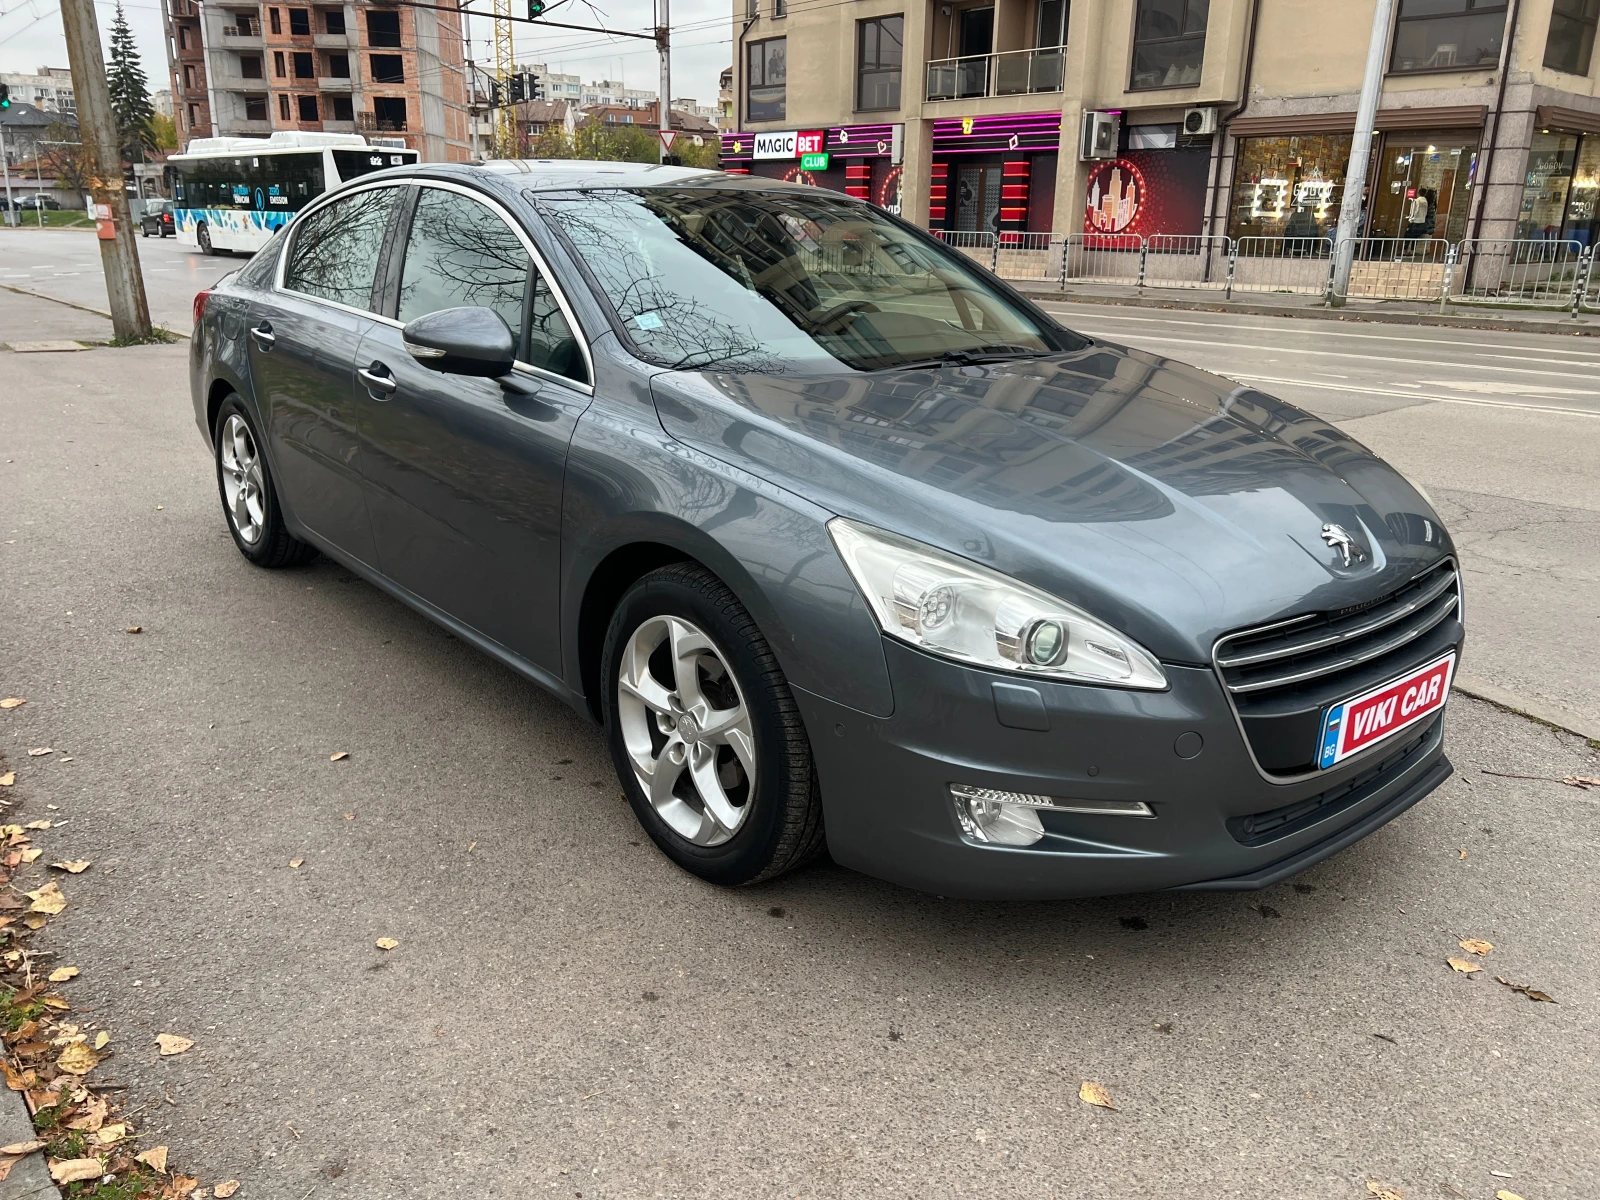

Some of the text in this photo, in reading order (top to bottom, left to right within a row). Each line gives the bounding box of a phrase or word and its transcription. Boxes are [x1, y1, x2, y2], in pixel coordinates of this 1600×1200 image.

[757, 136, 821, 153] MAGIC BET
[804, 157, 826, 168] CLUB
[1353, 673, 1442, 741] VIKI CAR
[1324, 743, 1336, 758] BG
